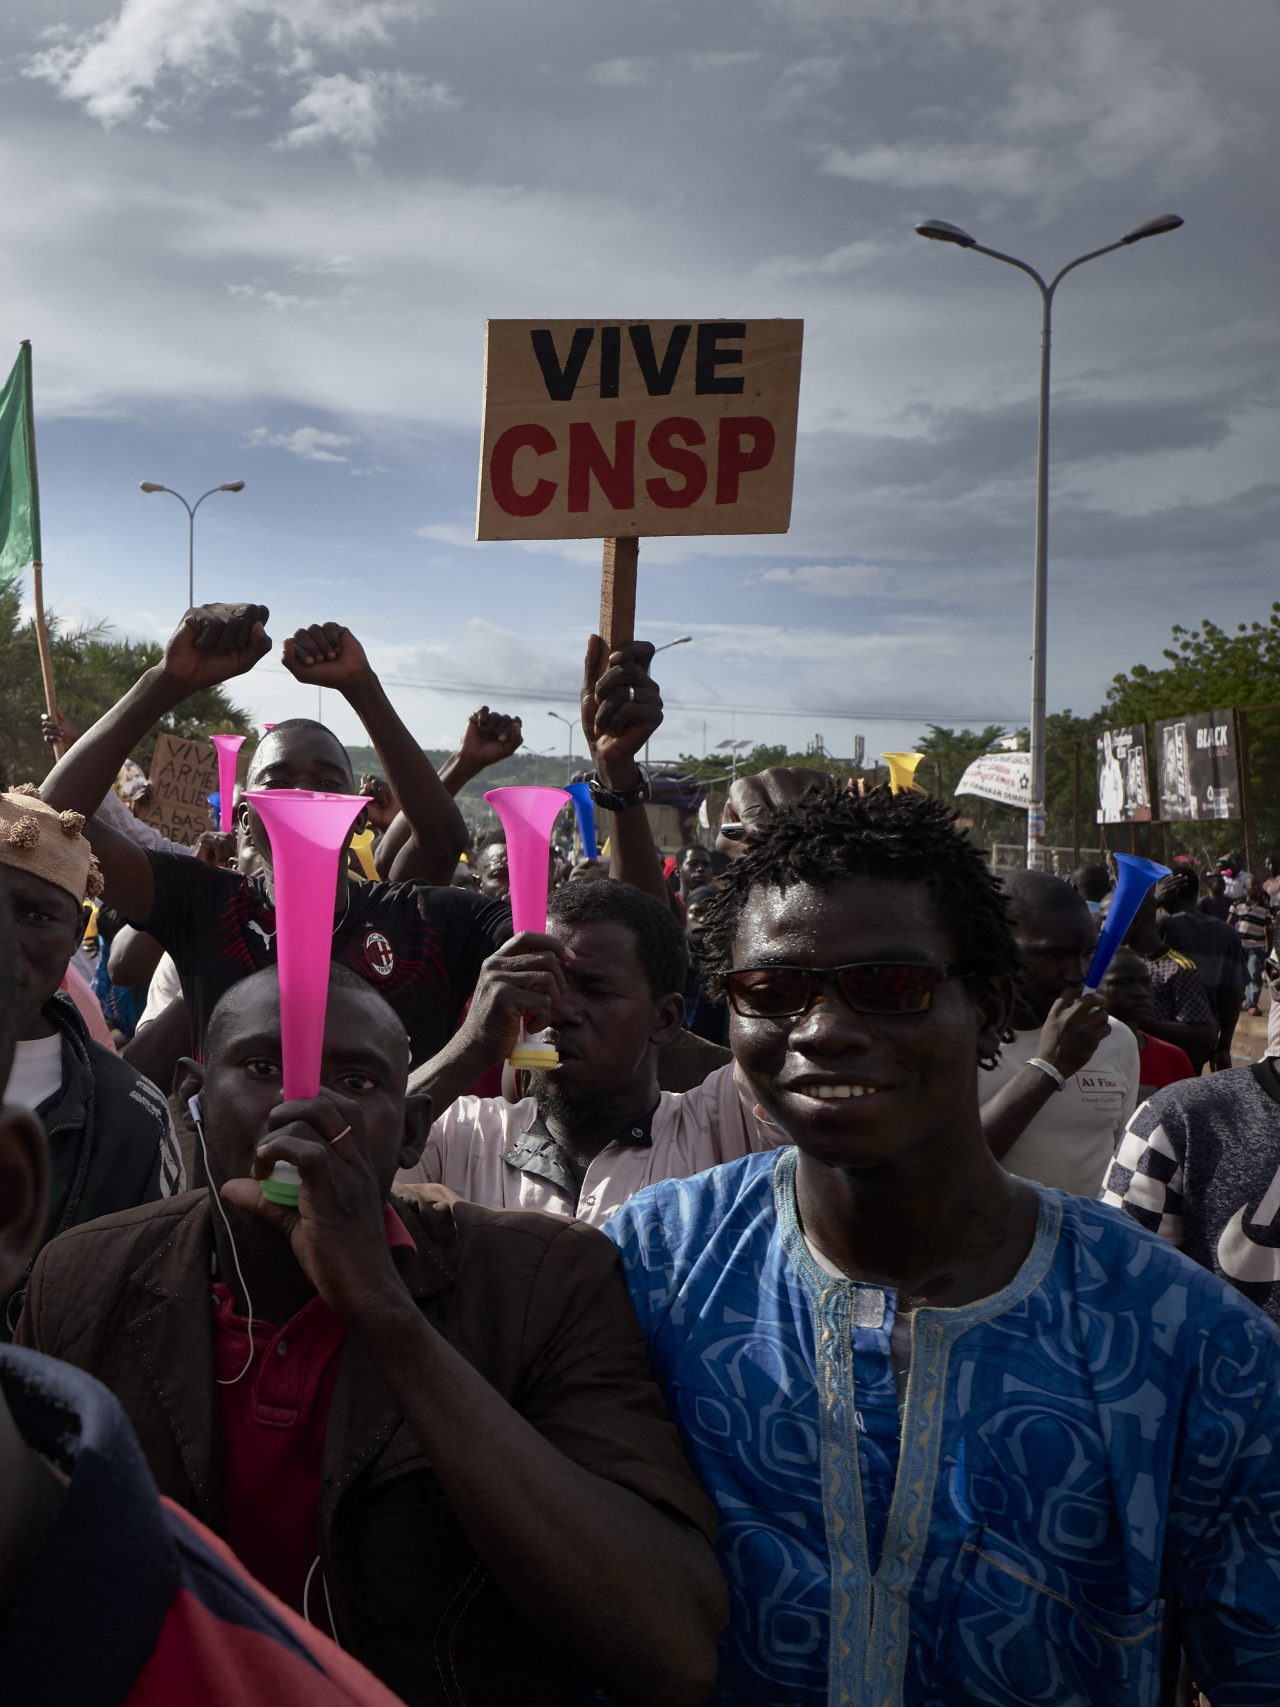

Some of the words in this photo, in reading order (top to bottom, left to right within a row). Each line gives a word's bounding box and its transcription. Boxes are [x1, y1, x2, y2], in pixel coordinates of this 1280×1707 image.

[531, 323, 746, 401] VIVE
[490, 416, 776, 517] CNSP
[1196, 725, 1228, 749] BLACK
[156, 780, 209, 809] MALIE
